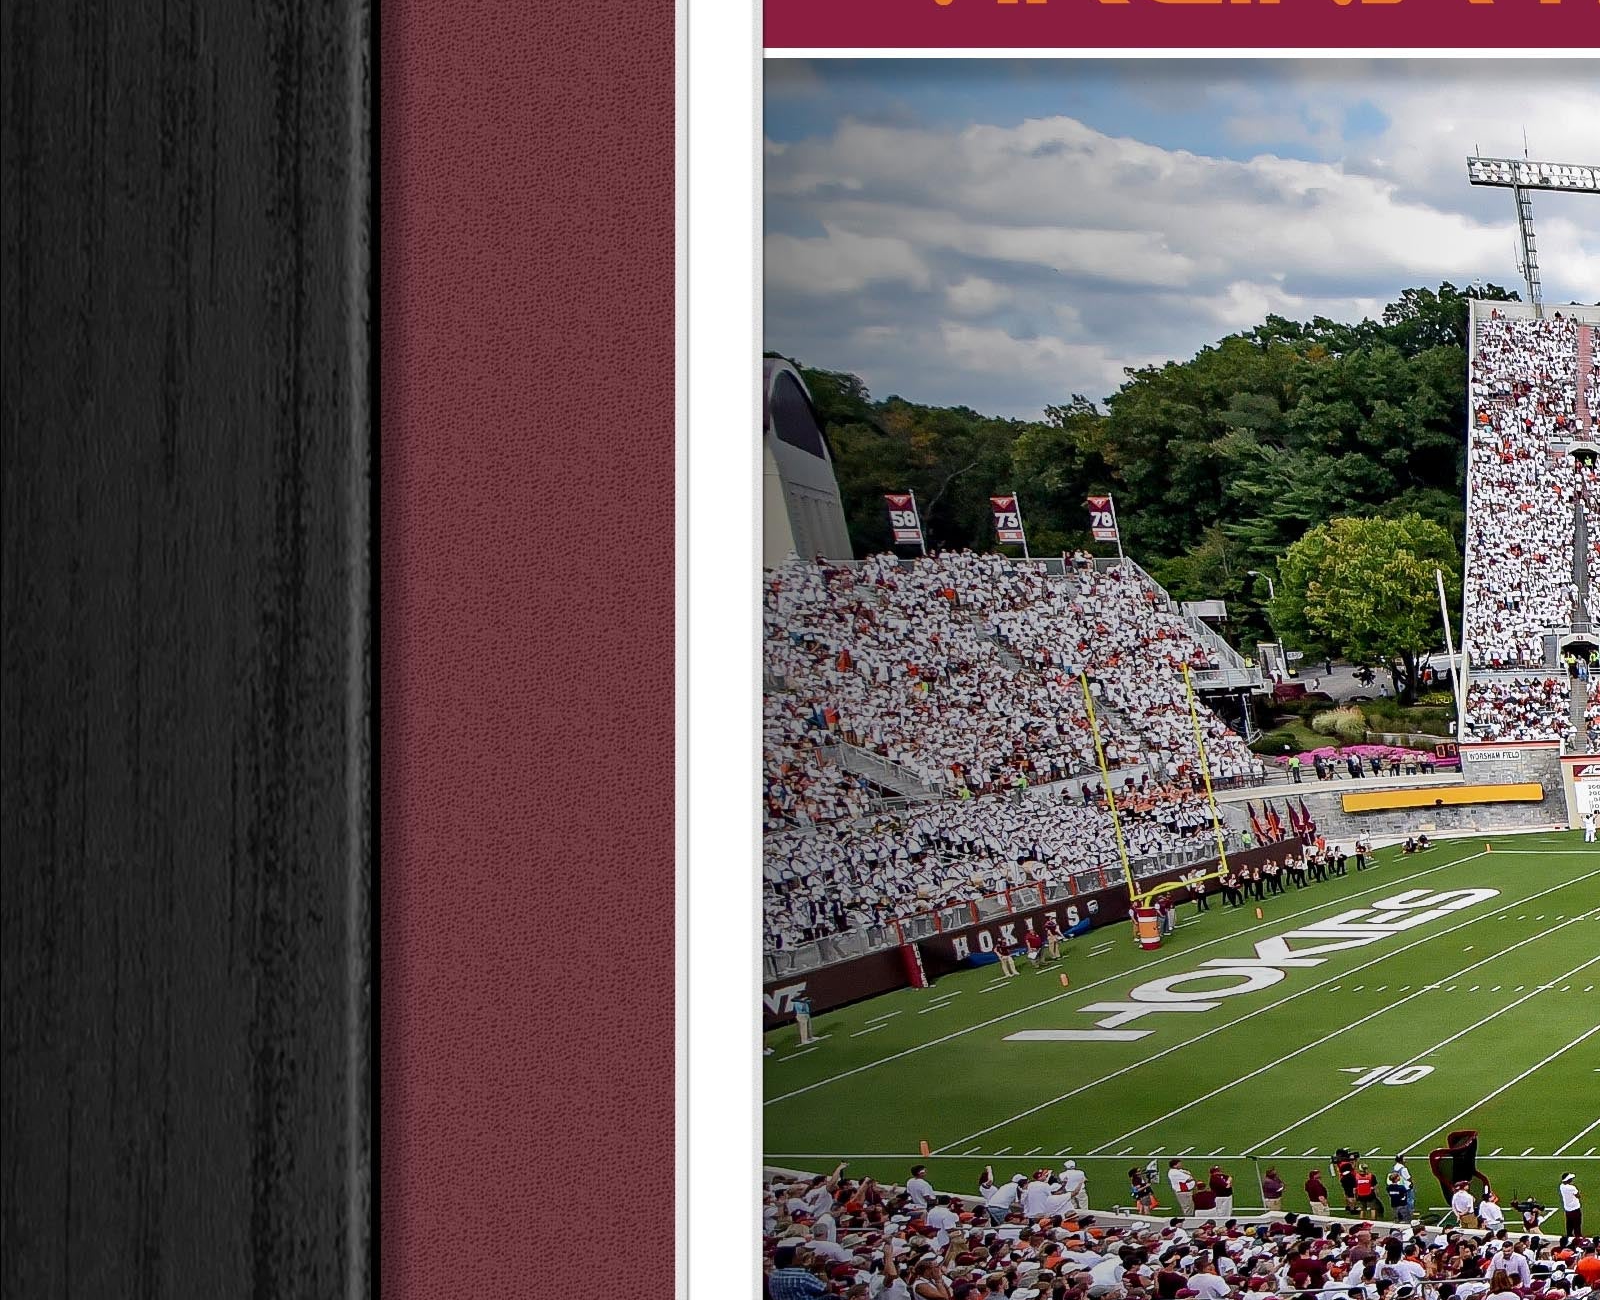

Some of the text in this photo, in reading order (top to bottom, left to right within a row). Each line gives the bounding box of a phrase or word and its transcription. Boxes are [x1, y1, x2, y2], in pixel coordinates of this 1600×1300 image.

[889, 510, 917, 528] 58
[995, 512, 1020, 528] 73
[1090, 511, 1114, 528] 78
[1002, 887, 1501, 1042] HOKIES
[1352, 1065, 1437, 1086] 10
